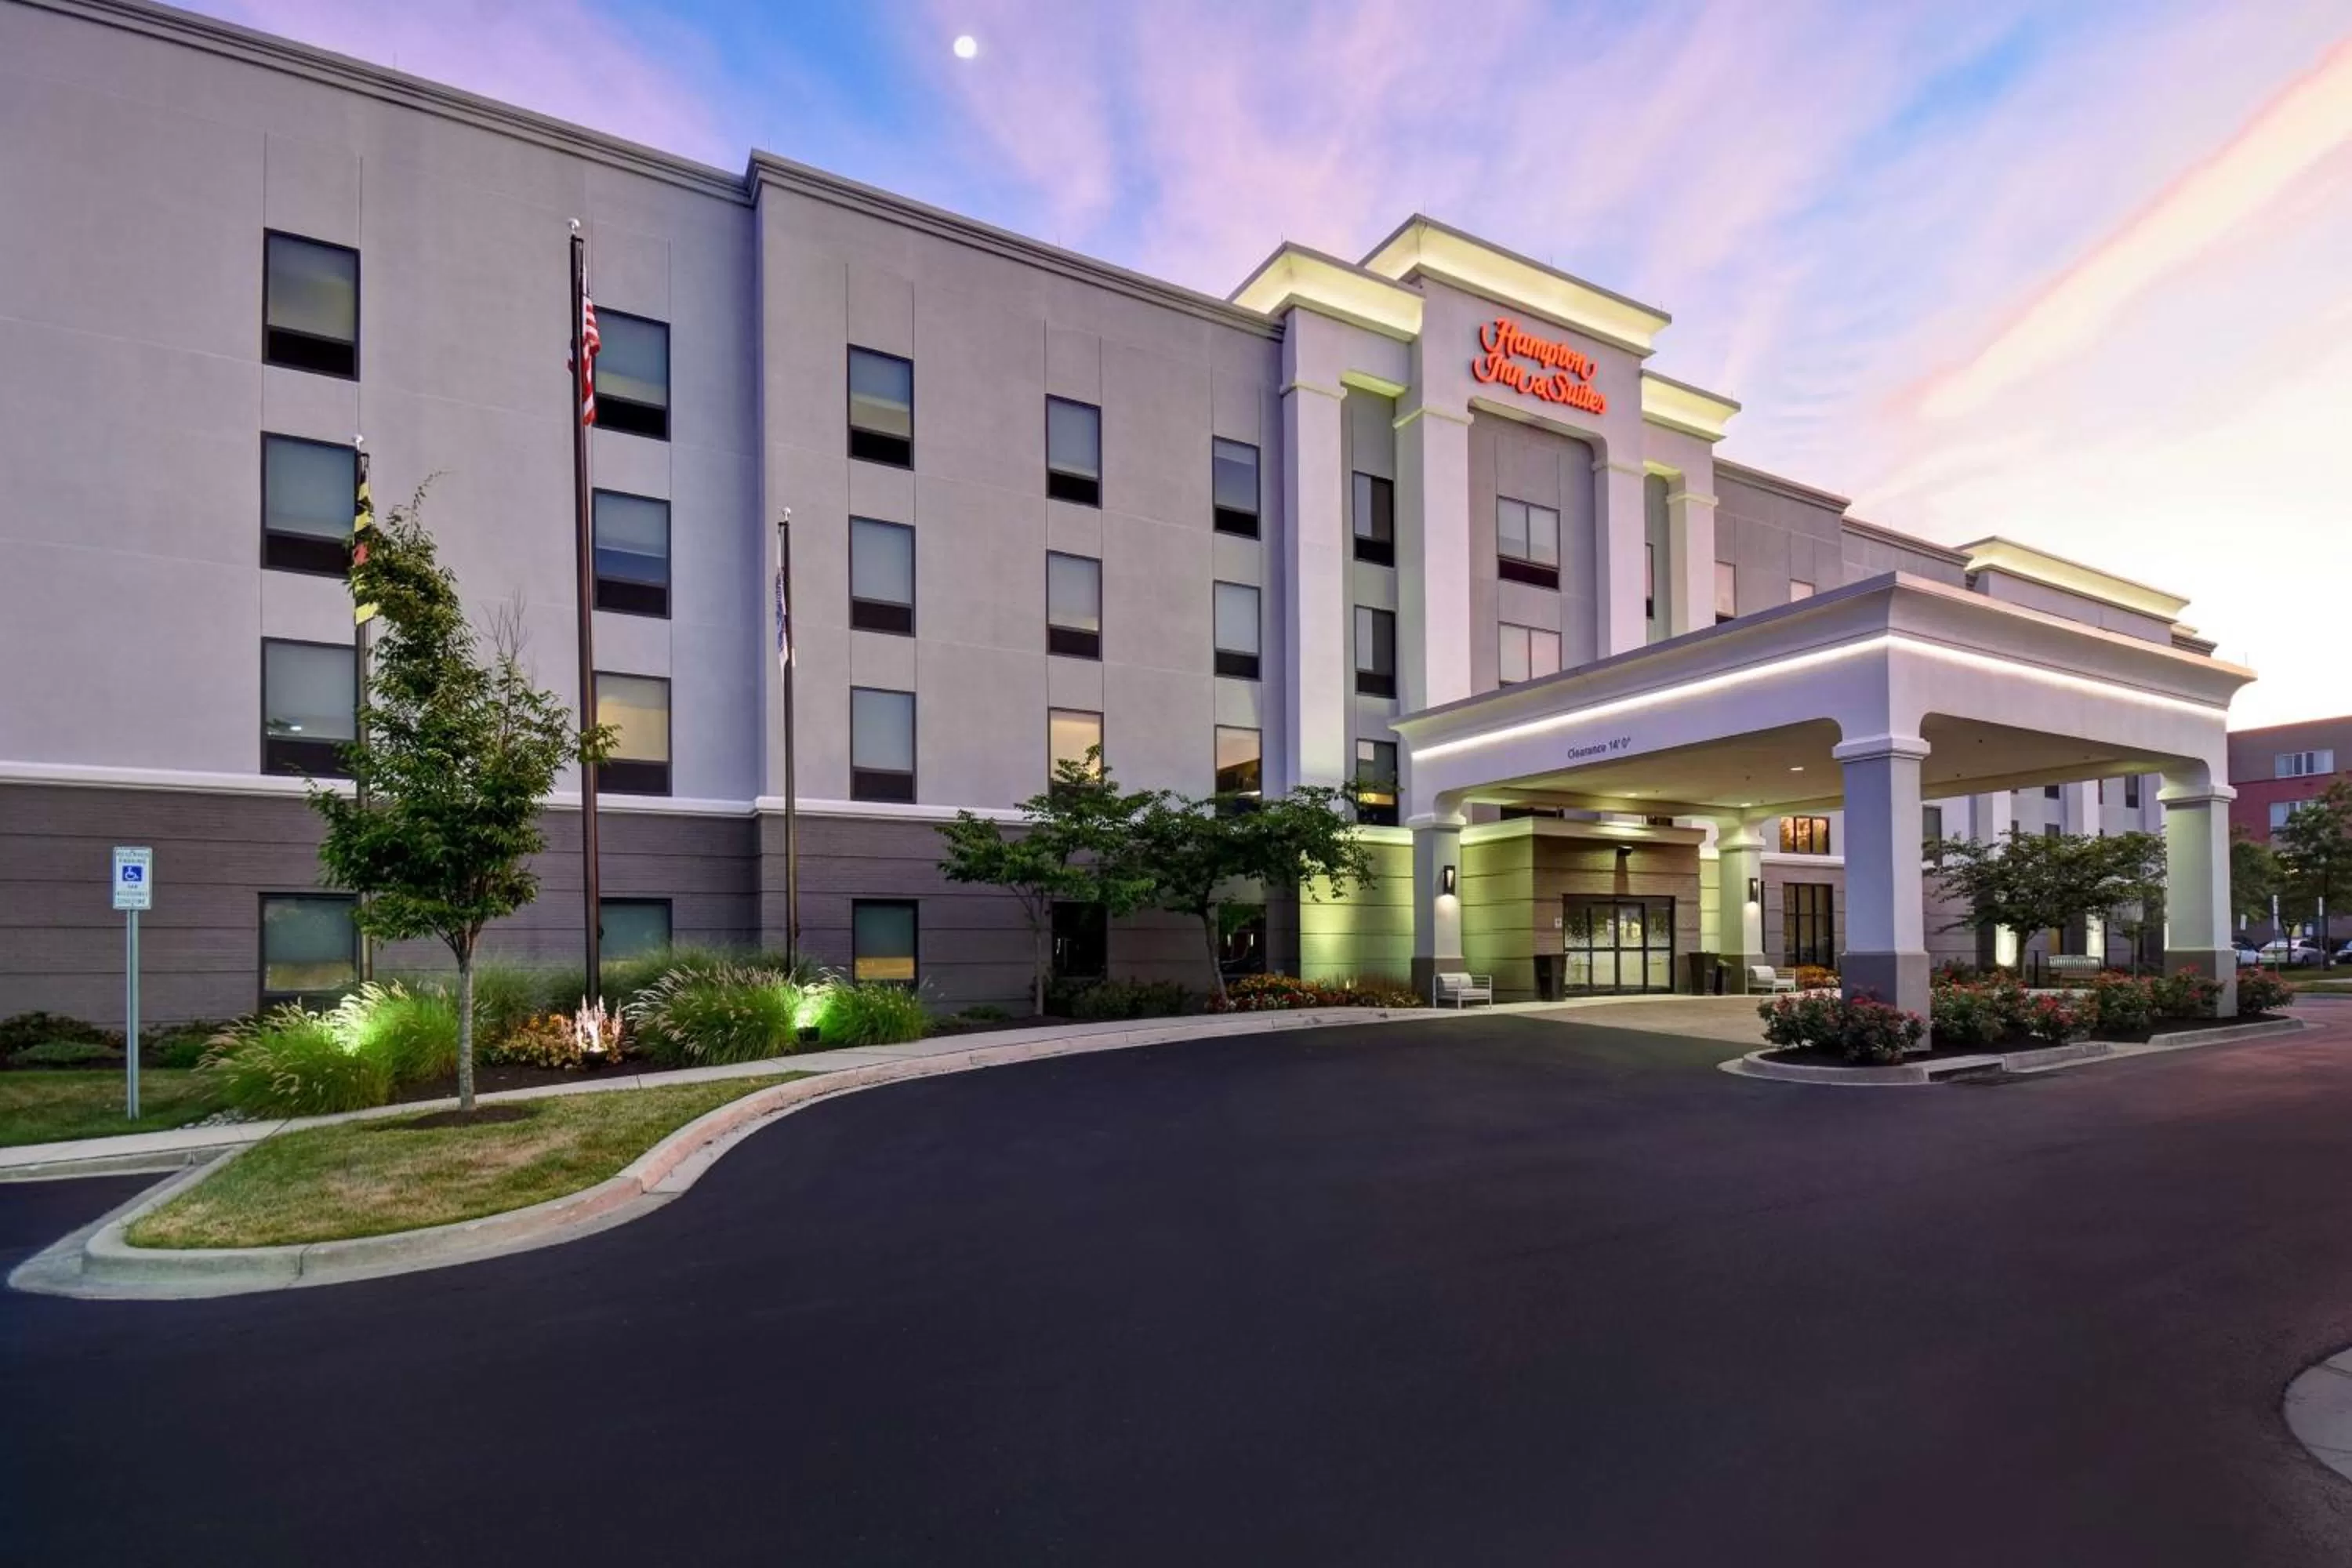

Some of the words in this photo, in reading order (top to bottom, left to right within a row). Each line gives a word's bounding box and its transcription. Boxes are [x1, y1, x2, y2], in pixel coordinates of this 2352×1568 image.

[1479, 317, 1599, 381] Hampton
[1472, 353, 1534, 394] Inn
[1534, 376, 1550, 401] &
[1547, 371, 1607, 415] Suites
[1568, 744, 1606, 760] Clearance
